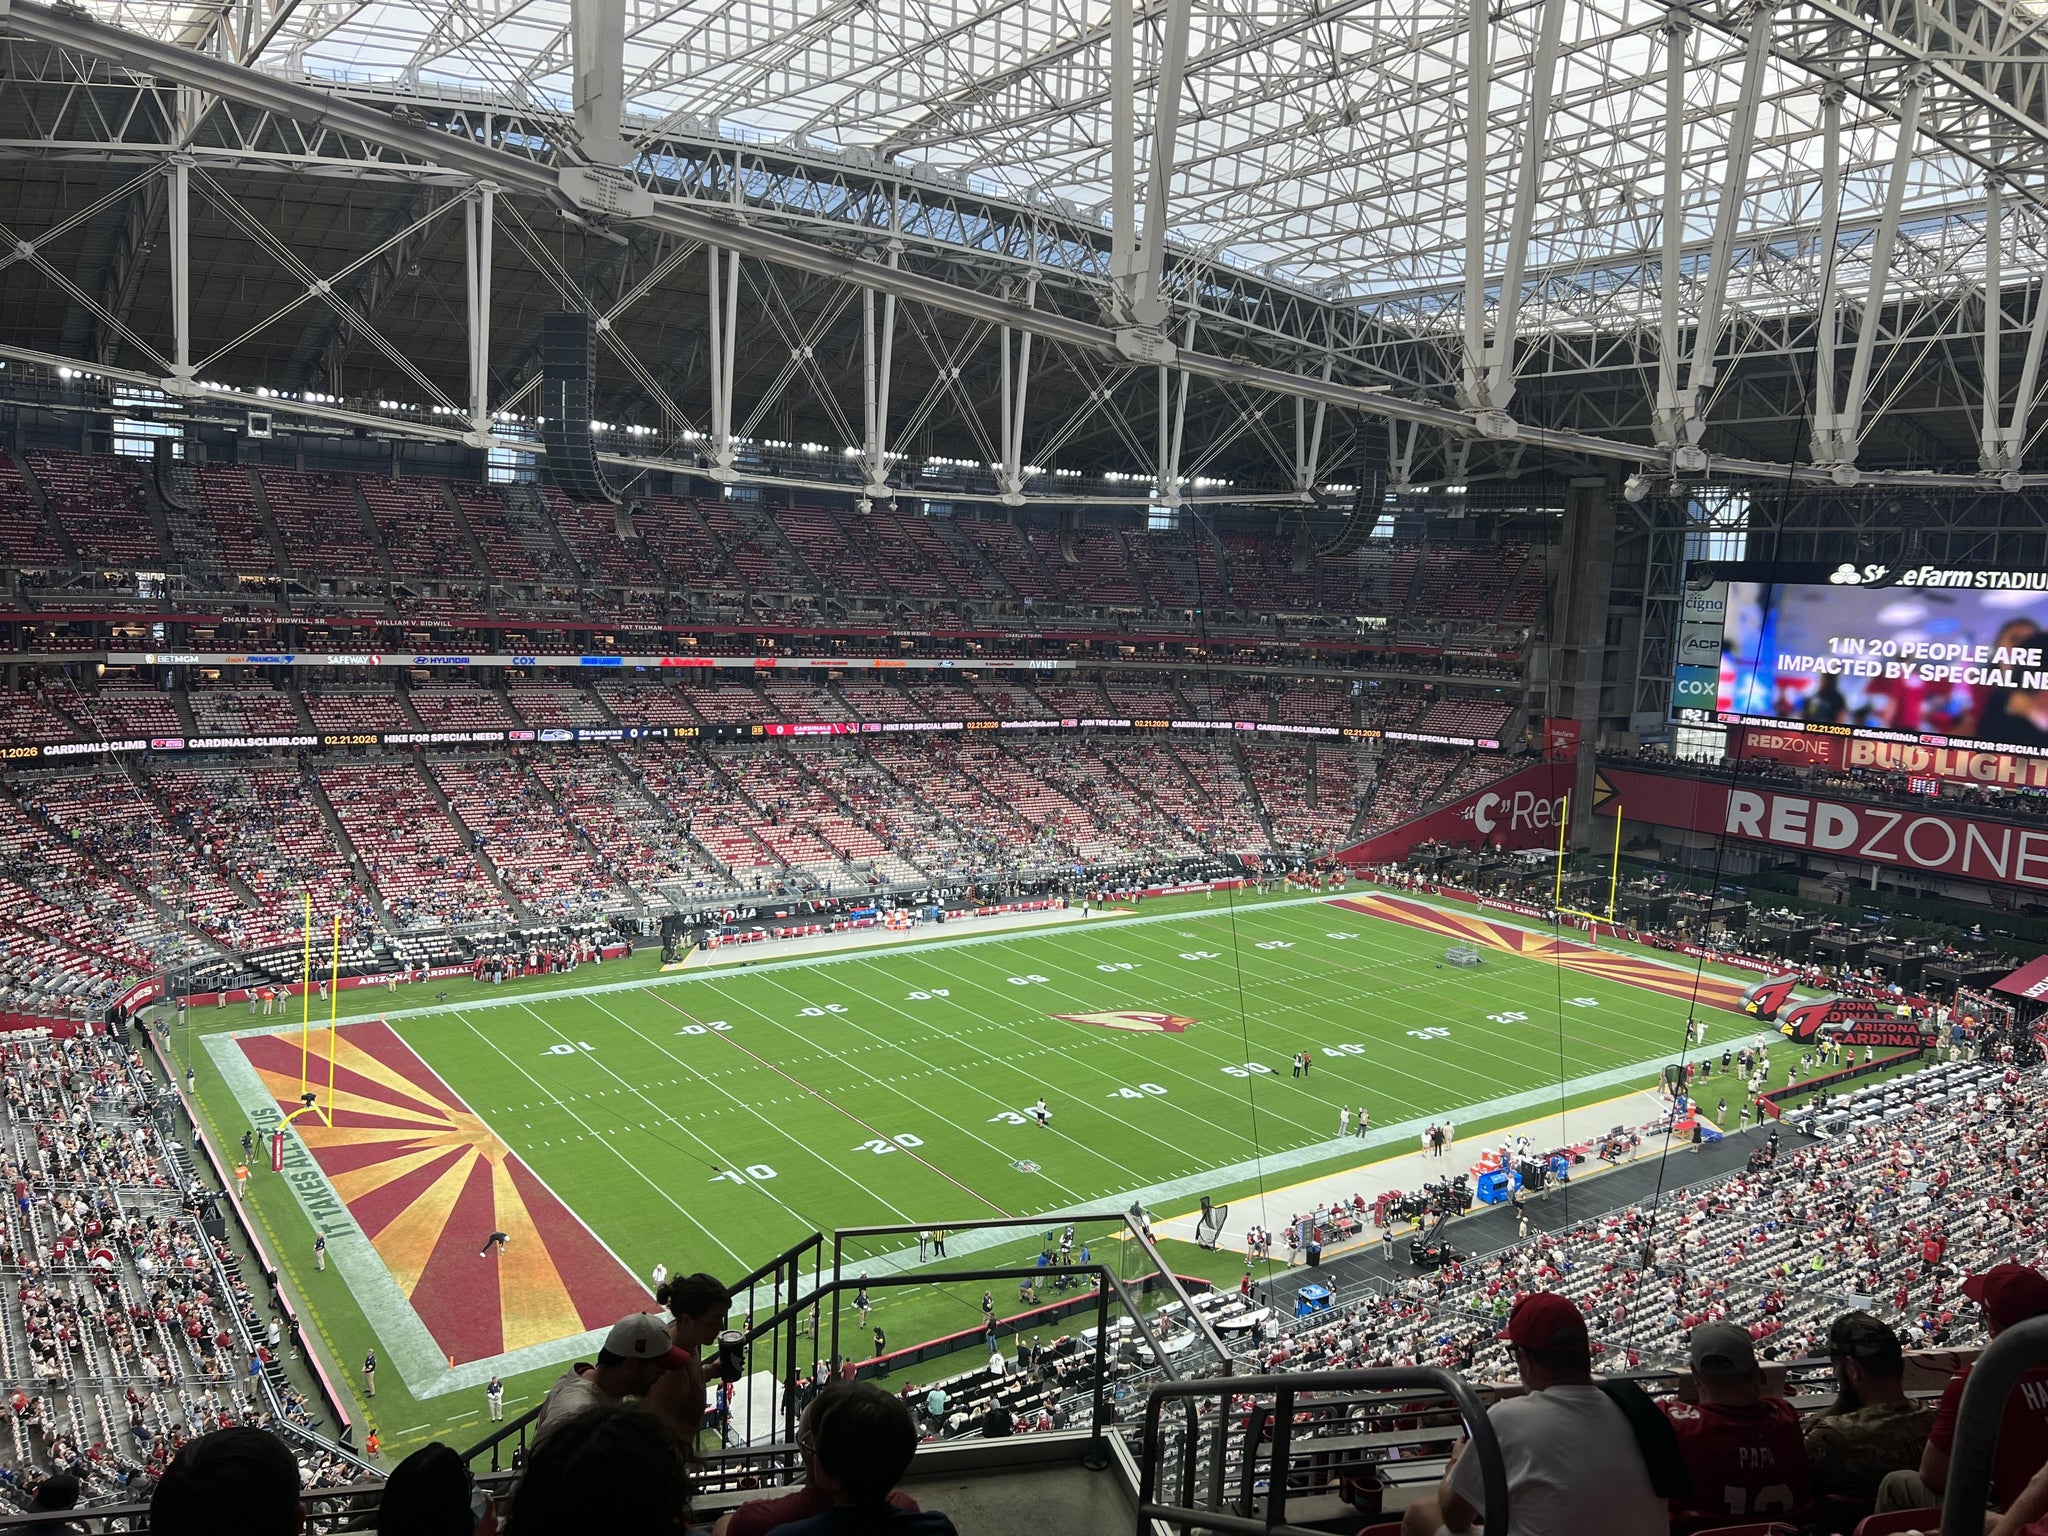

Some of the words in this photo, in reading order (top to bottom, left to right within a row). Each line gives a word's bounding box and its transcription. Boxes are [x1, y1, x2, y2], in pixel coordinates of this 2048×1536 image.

[1686, 598, 1723, 612] cigna
[222, 616, 262, 624] CHARLES
[276, 617, 313, 625] BIDWILL,
[420, 620, 452, 628] BIDWILL
[1687, 639, 1720, 650] ACP
[1828, 637, 1839, 654] 1
[1843, 637, 1866, 656] IN
[1868, 639, 1897, 658] 20
[1901, 641, 1989, 664] PEOPLE
[1992, 646, 2042, 667] ARE
[157, 655, 199, 663] BETMGM
[327, 655, 369, 665] SAFEWAY
[430, 656, 470, 664] HYUNDAI
[512, 656, 536, 665] COX
[1029, 660, 1058, 669] AVNET
[1777, 654, 1882, 677] IMPACTED
[1885, 661, 1917, 680] BY
[1919, 663, 2018, 688] SPECIAL
[1678, 680, 1715, 696] COX
[914, 722, 941, 731] SPECIAL
[1171, 720, 1211, 729] CARDINALS
[1740, 716, 1761, 727] JOIN
[1761, 718, 1778, 729] THE
[1778, 720, 1805, 731] CLIMB
[1806, 723, 1851, 736] 02.21.2026
[384, 734, 409, 744] HIKE
[409, 733, 430, 743] FOR
[430, 732, 472, 742] SPECIAL
[473, 732, 505, 742] NEEDS
[673, 727, 700, 737] 19:21
[1418, 733, 1449, 744] SPECIAL
[188, 736, 318, 749] CARDINALSCLIMB.COM
[324, 735, 378, 745] 02.21.2026
[1748, 733, 1830, 756] REDZONE
[1948, 738, 1974, 749] HIKE
[1974, 740, 1995, 751] FOR
[1995, 742, 2040, 755] SPECIAL
[43, 742, 110, 756] CARDINALS
[110, 740, 147, 751] CLIMB
[1850, 738, 1930, 772] BUD
[1933, 749, 2048, 787] LIGHT
[1725, 788, 2048, 891] REDZONE
[1727, 956, 1780, 976] CARDINALS
[1006, 974, 1050, 986] 50
[914, 988, 951, 1000] 40
[1564, 997, 1597, 1008] 10
[803, 1003, 849, 1018] 30
[1486, 1010, 1525, 1025] 20
[683, 1020, 734, 1036] 20
[1406, 1026, 1446, 1041] 30
[1852, 1022, 1918, 1034] ARIZONA
[550, 1041, 597, 1056] 10
[1322, 1043, 1362, 1058] 40
[1220, 1062, 1272, 1079] 50
[1120, 1082, 1168, 1101] 40
[863, 1132, 925, 1155] 20
[722, 1163, 779, 1187] 10
[290, 1170, 344, 1221] TAKES
[321, 1222, 357, 1241] IT
